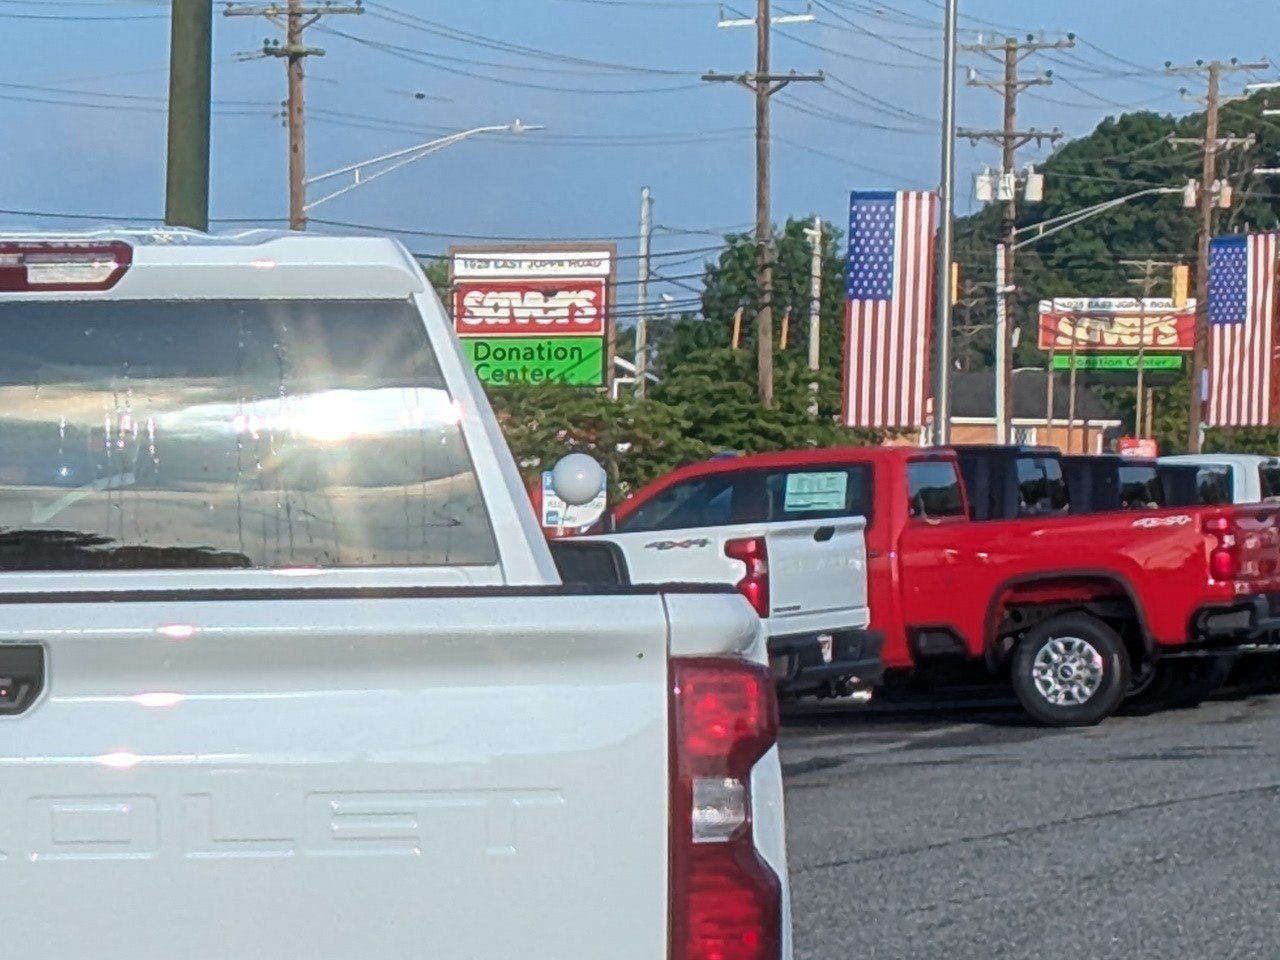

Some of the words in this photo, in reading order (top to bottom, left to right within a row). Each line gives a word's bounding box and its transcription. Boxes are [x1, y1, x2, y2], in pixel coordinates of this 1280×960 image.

[494, 258, 522, 269] EAST
[568, 258, 602, 268] ROAD
[474, 341, 582, 362] Donation
[475, 363, 553, 383] Center
